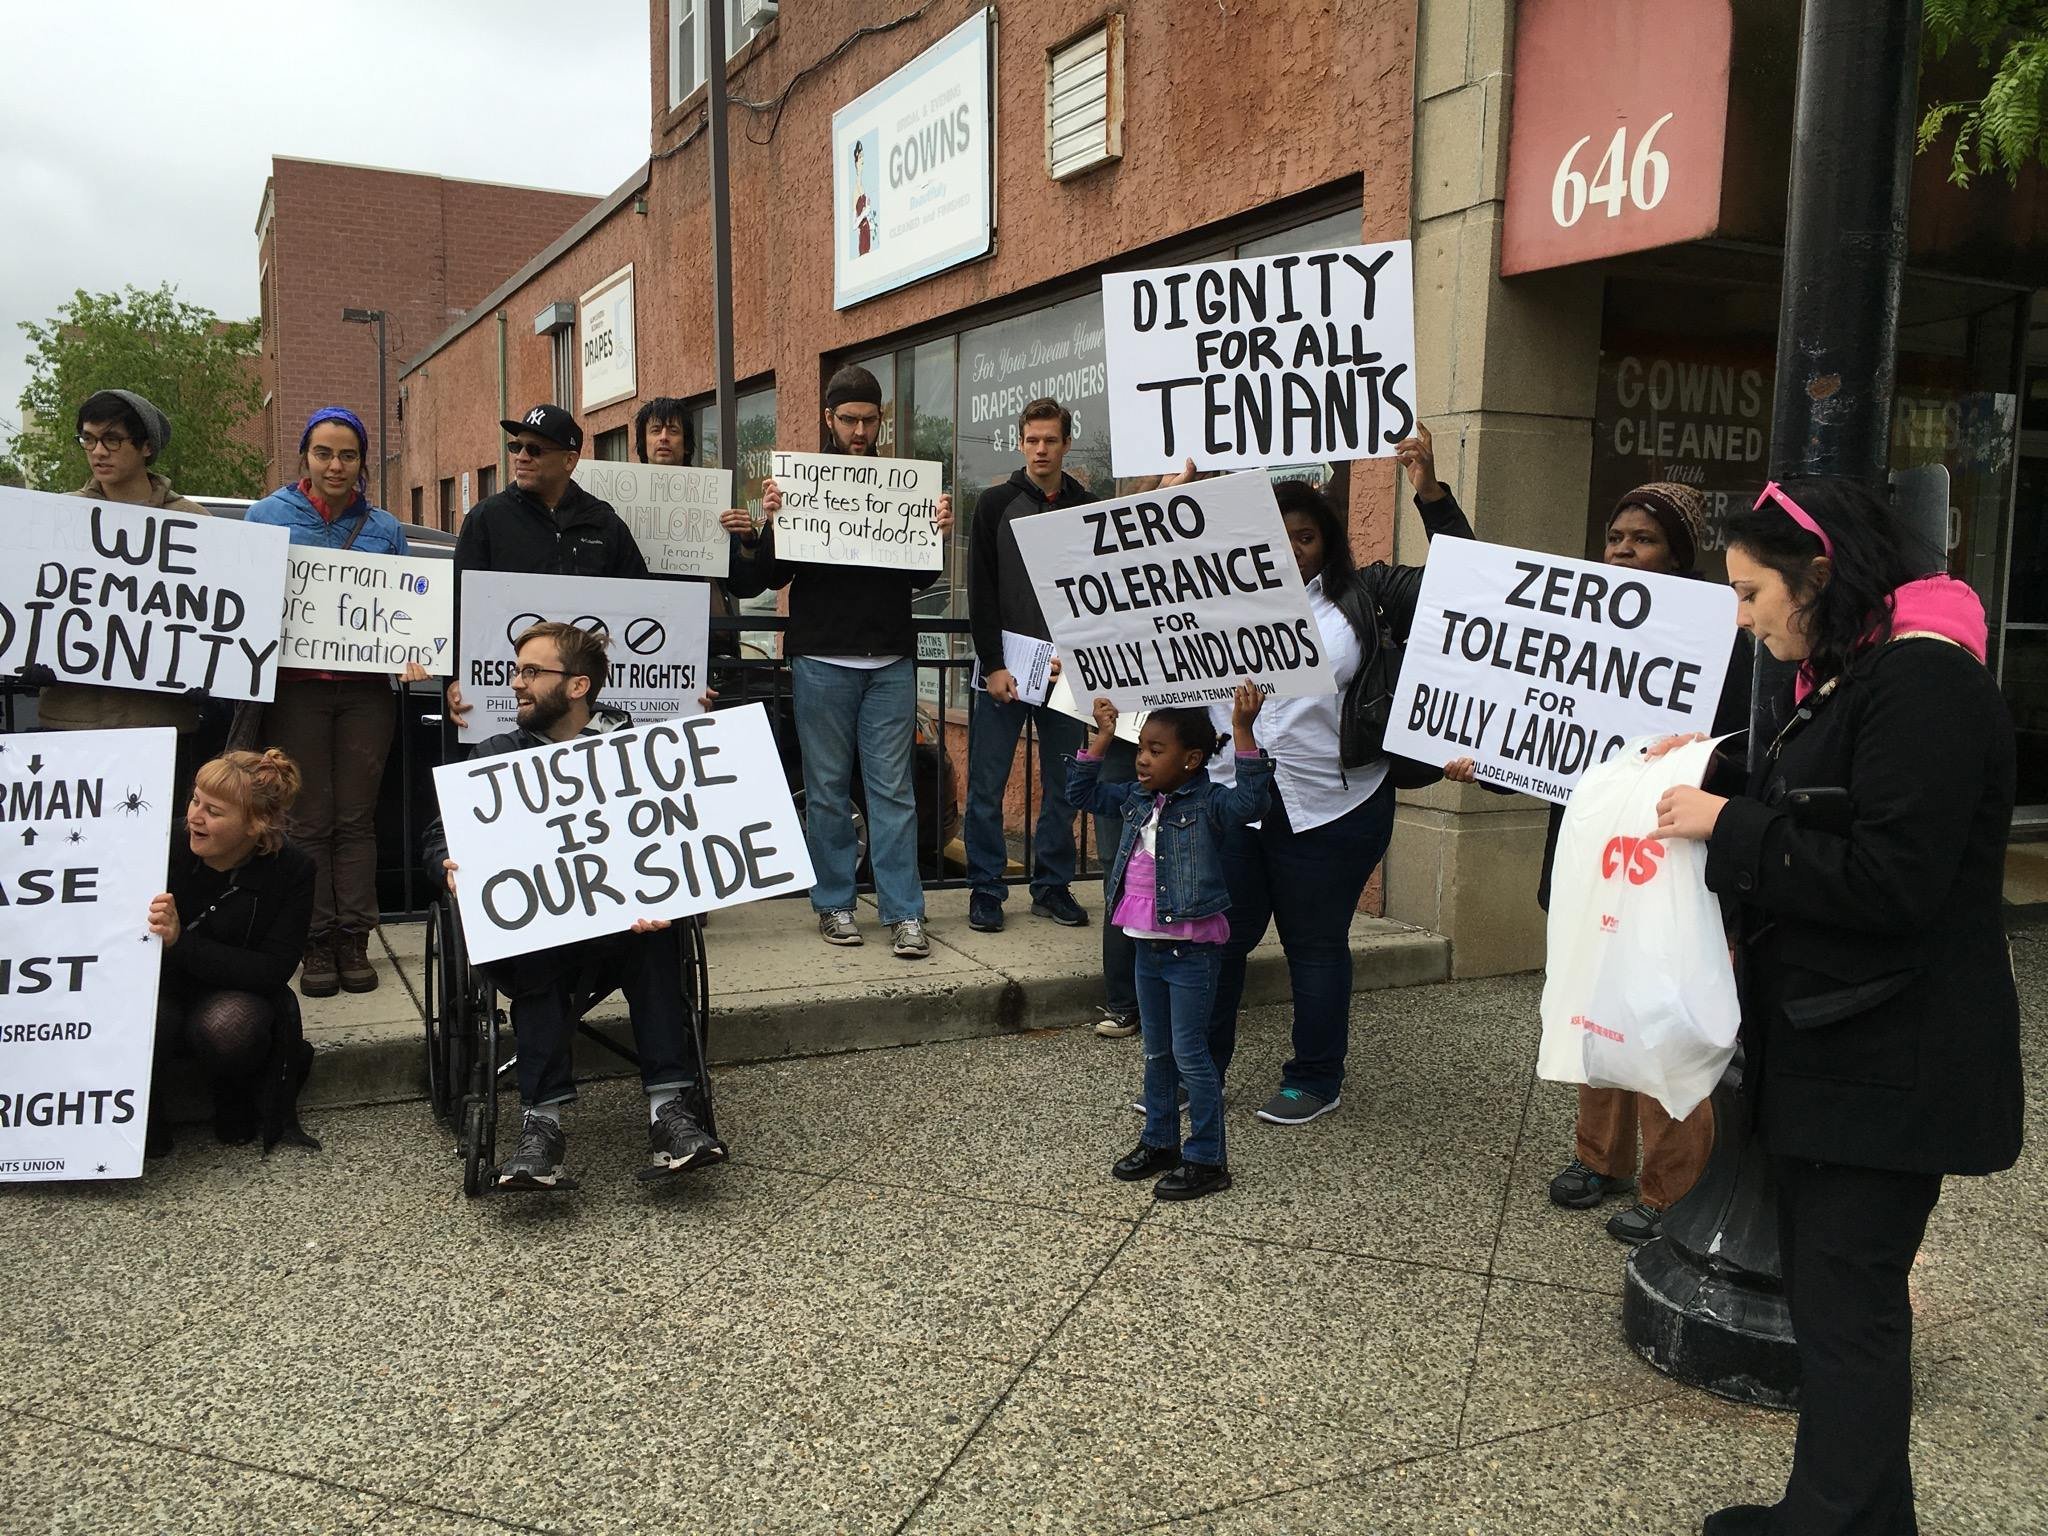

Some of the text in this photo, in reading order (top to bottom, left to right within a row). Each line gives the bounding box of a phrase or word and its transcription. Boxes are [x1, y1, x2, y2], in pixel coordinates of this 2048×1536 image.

[889, 103, 970, 189] GOWNS
[1551, 112, 1674, 228] 646
[1133, 250, 1393, 332] DIGNITY
[585, 329, 613, 367] DRAPES
[972, 353, 994, 382] For
[998, 347, 1026, 382] Your
[1028, 340, 1069, 367] Dream
[1196, 322, 1382, 372] FOR ALL
[972, 385, 1023, 423] DRAPES
[1617, 356, 1763, 418] GOWNS
[1136, 363, 1414, 457] TENANTS
[1614, 417, 1763, 462] CLEANED
[591, 469, 638, 502] NO
[650, 472, 720, 505] MORE
[775, 455, 918, 497] Ingerman, no
[1664, 464, 1706, 484] With
[824, 490, 860, 513] fees
[865, 493, 893, 514] for
[91, 506, 198, 575] WE
[778, 515, 831, 546] ering
[839, 517, 941, 547] outdoors!
[1083, 495, 1205, 556] ZERO
[661, 558, 700, 572] Union
[663, 544, 714, 560] Tenants
[36, 562, 245, 633] DEMAND
[400, 572, 430, 595] no
[1055, 543, 1283, 618] TOLERANCE
[1505, 560, 1652, 630] ZERO
[337, 593, 413, 635] fake
[1153, 612, 1199, 634] FOR
[1073, 641, 1149, 691] BULLY
[1152, 618, 1319, 683] LANDLORDS
[1442, 609, 1701, 715] TOLERANCE
[630, 664, 696, 690] RIGHTS!
[1142, 691, 1201, 706] PHILADELPHIA
[1202, 687, 1236, 701] TENANT
[641, 701, 680, 711] UNION
[1407, 683, 1497, 750] BULLY
[1524, 687, 1576, 718] FOR
[468, 718, 737, 824] JUSTICE
[546, 793, 698, 853] IS ON
[482, 821, 794, 930] OUR SIDE
[22, 1160, 65, 1172] UNION
